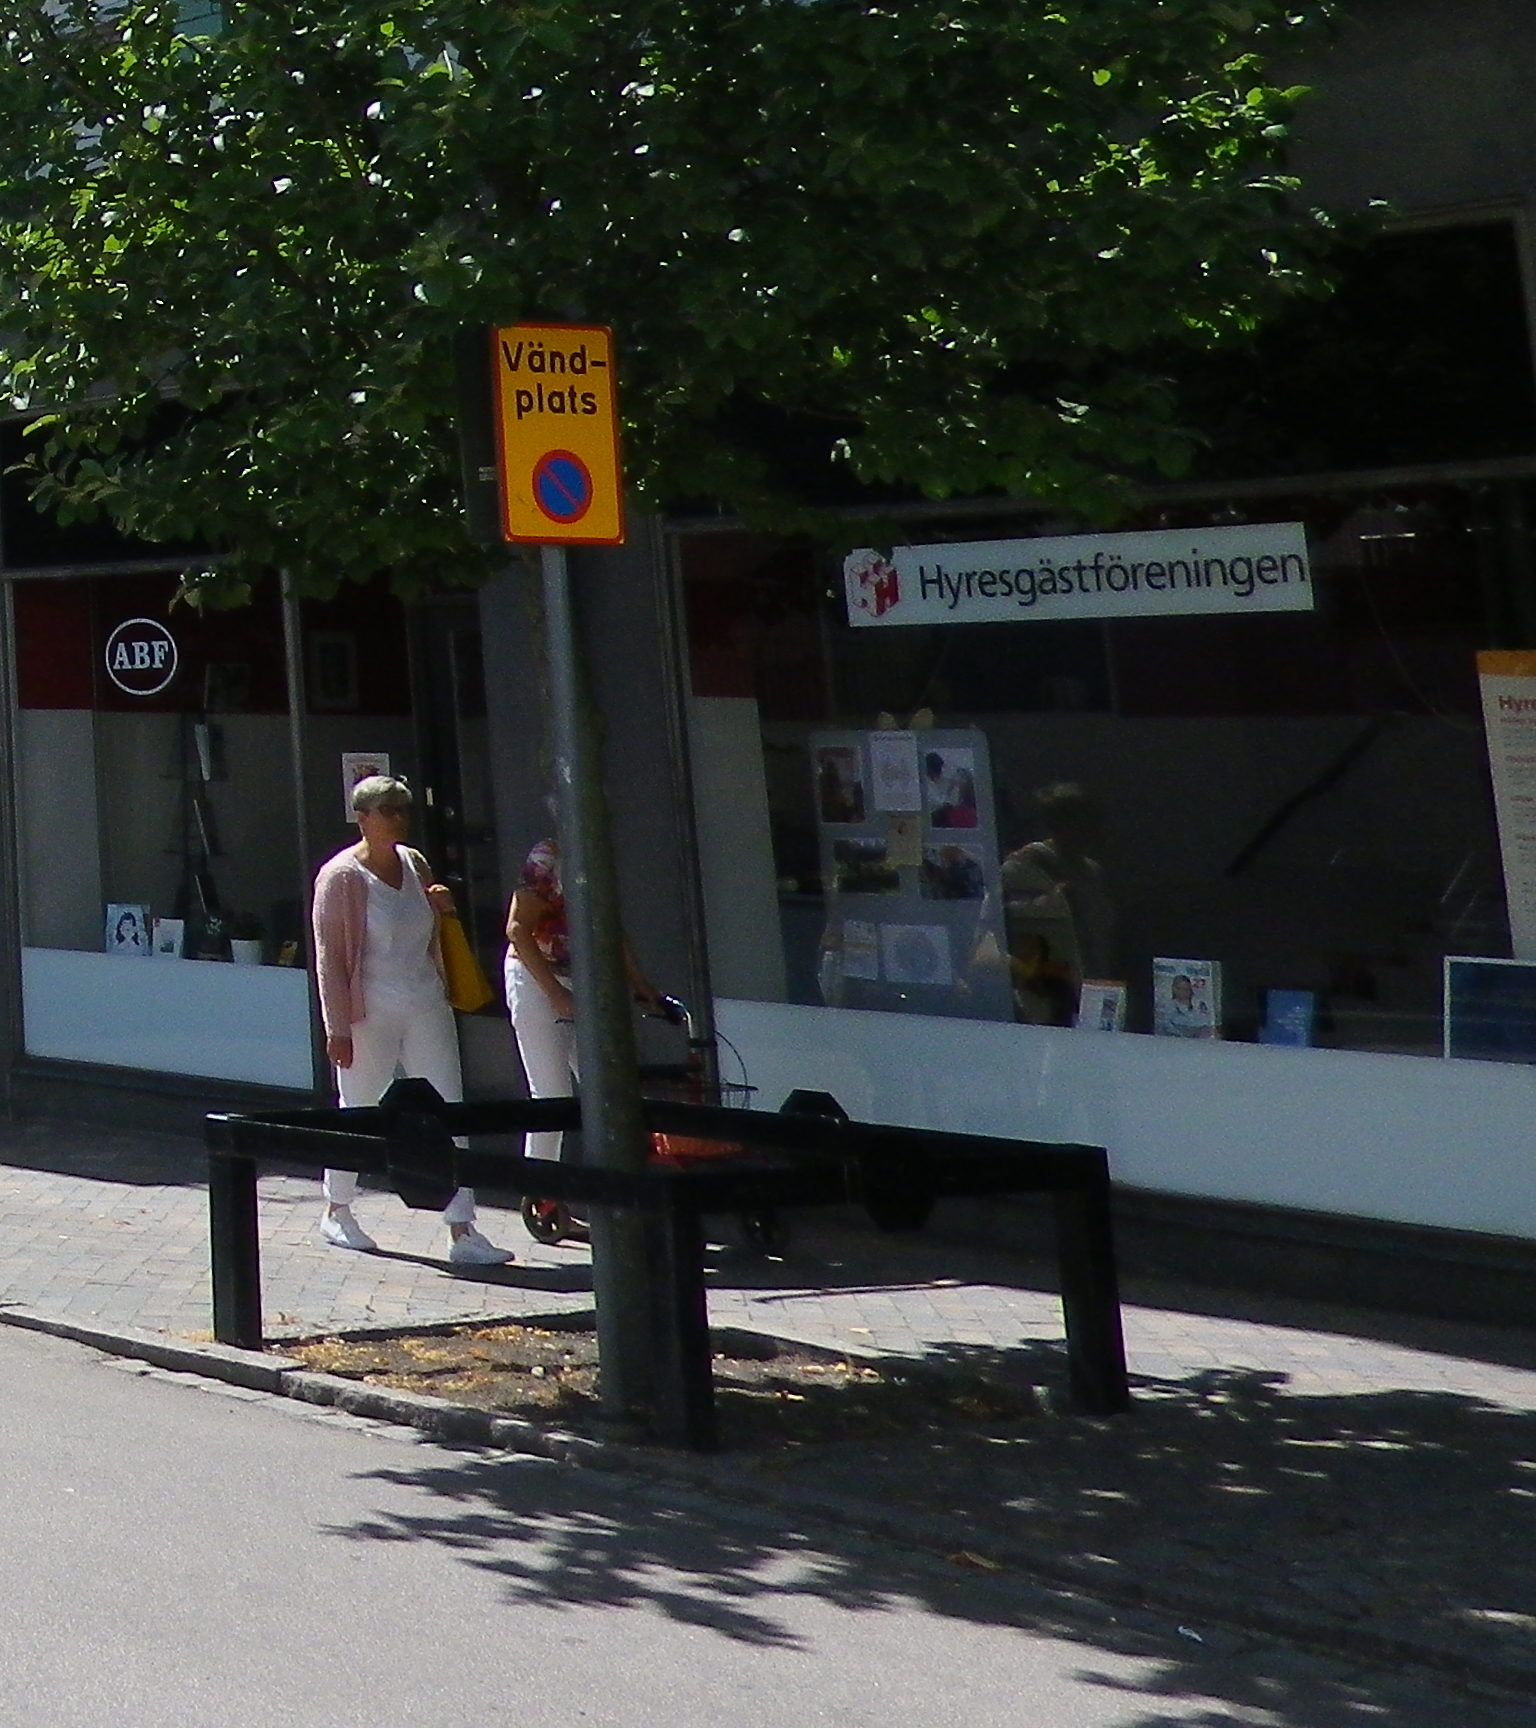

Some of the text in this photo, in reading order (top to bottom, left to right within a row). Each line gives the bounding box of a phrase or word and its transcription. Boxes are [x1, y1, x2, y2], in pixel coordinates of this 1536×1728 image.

[501, 340, 607, 375] Vänd-
[515, 382, 598, 420] plats
[918, 548, 1307, 610] Hyresgästföreningen
[112, 640, 169, 670] ABF
